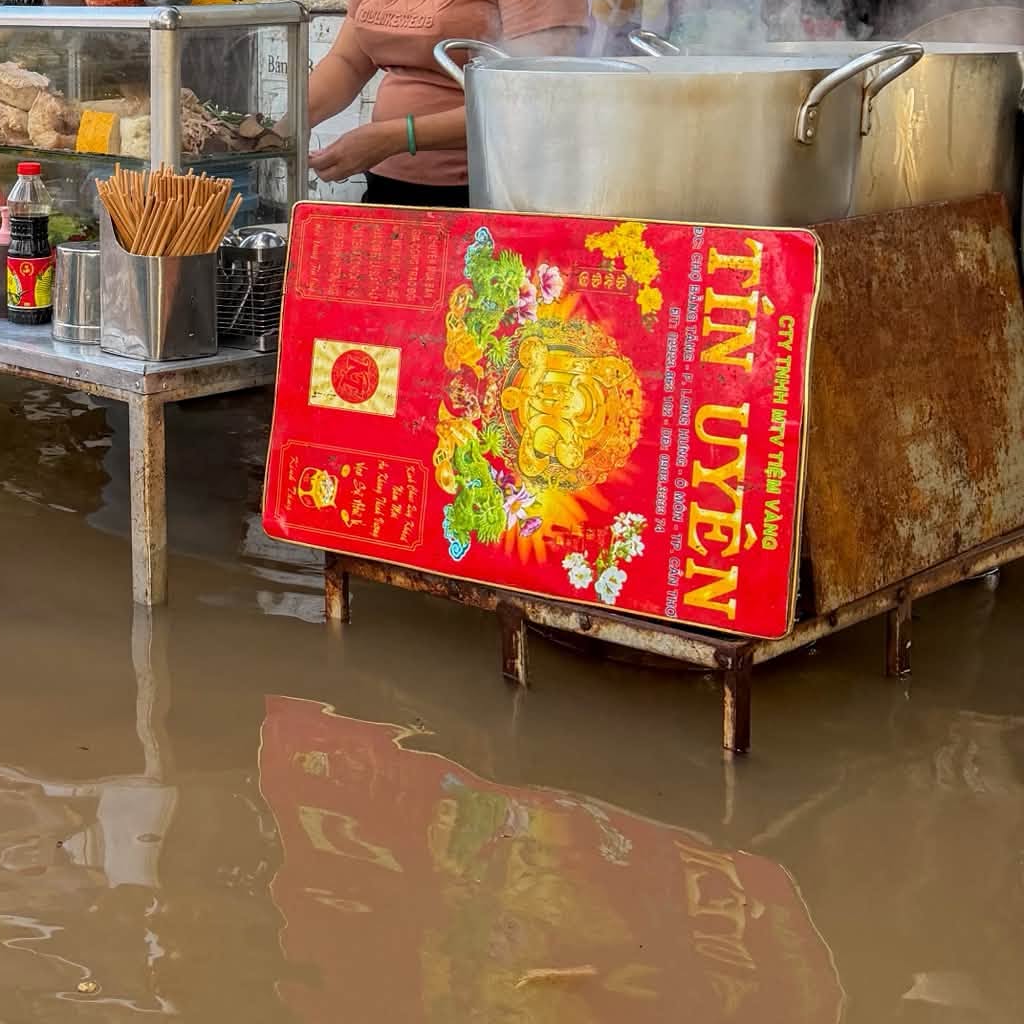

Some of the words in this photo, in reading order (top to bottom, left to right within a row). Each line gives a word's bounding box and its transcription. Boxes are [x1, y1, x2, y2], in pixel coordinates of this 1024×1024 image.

[688, 253, 702, 282] CHỢ
[700, 237, 776, 374] TÍN
[777, 315, 795, 351] CTY
[773, 355, 792, 404] TNHH
[677, 388, 691, 425] LONG
[769, 408, 787, 447] MTV
[764, 451, 786, 495] TIỆM
[672, 491, 687, 521] MÔN
[683, 402, 757, 621] UYÊN
[762, 499, 784, 550] VÀNG
[669, 534, 681, 553] TP.
[664, 589, 679, 618] THƠ
